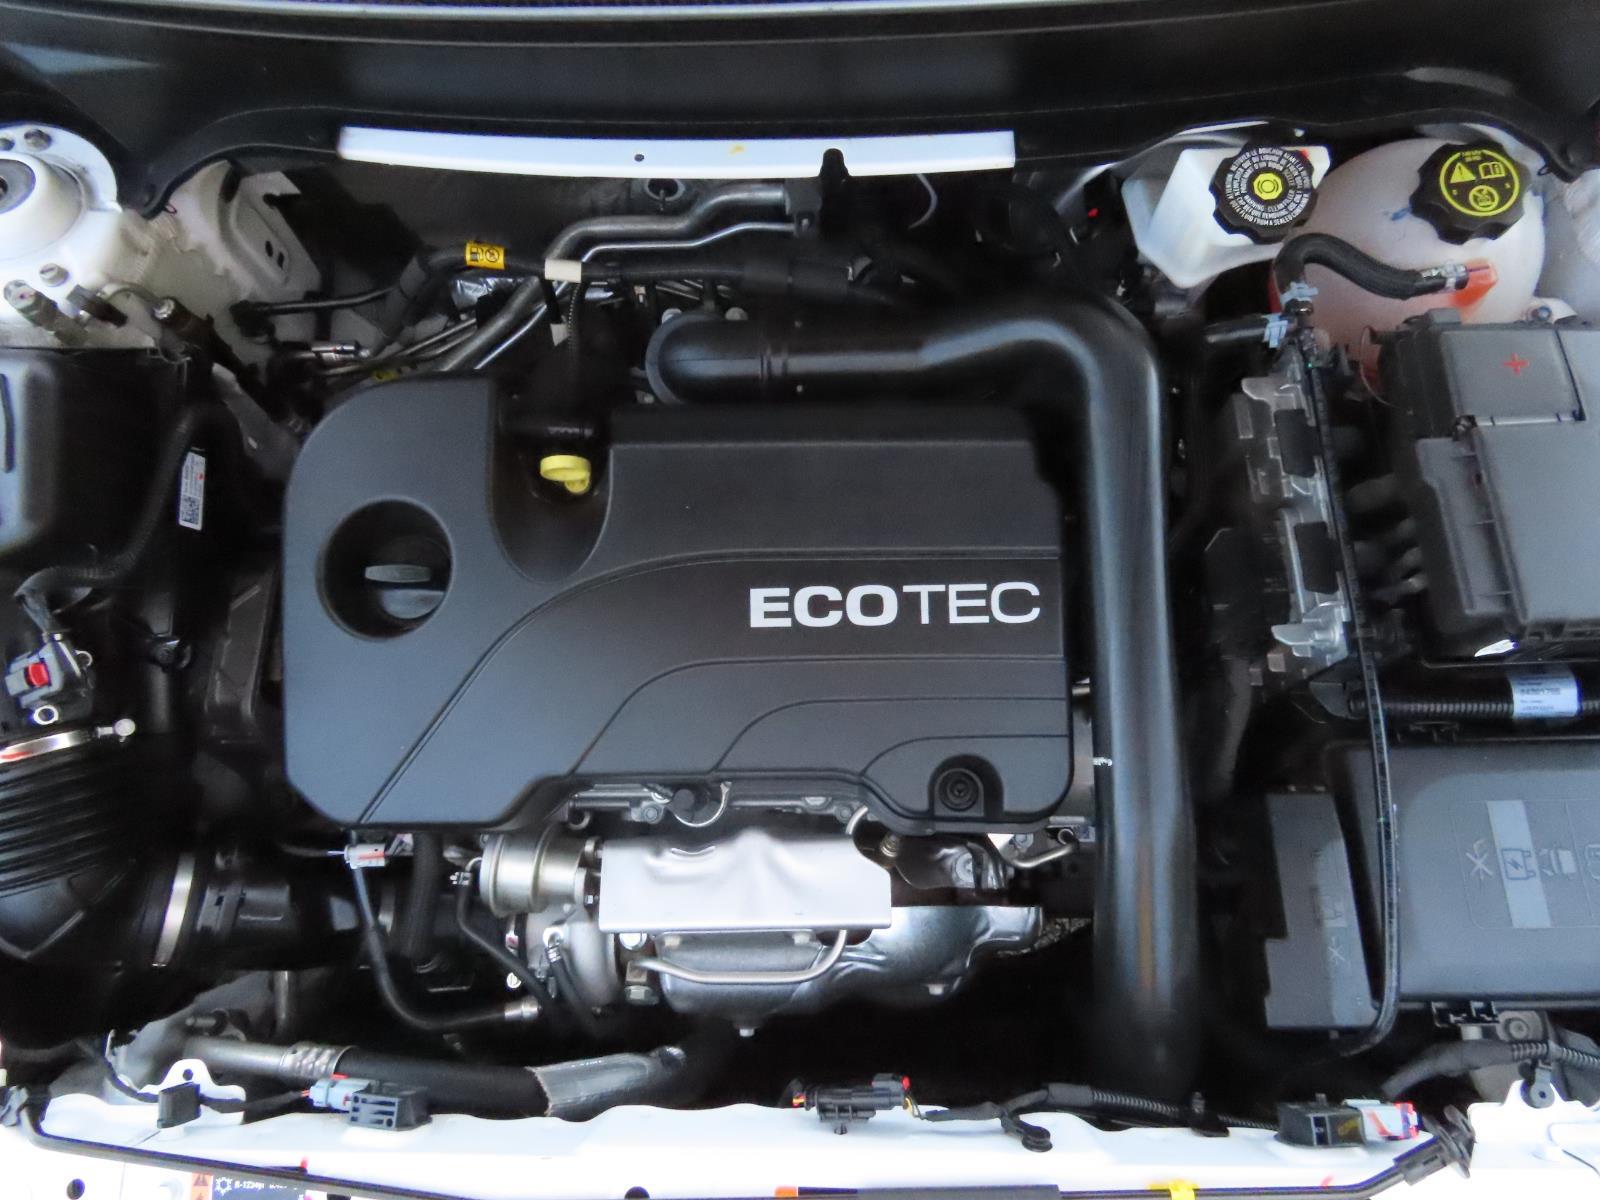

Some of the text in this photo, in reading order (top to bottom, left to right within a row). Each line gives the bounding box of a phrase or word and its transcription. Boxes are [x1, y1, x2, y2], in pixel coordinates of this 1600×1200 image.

[1253, 217, 1269, 225] FROM
[1273, 213, 1293, 224] SEALED
[750, 582, 1041, 628] ECOTEC
